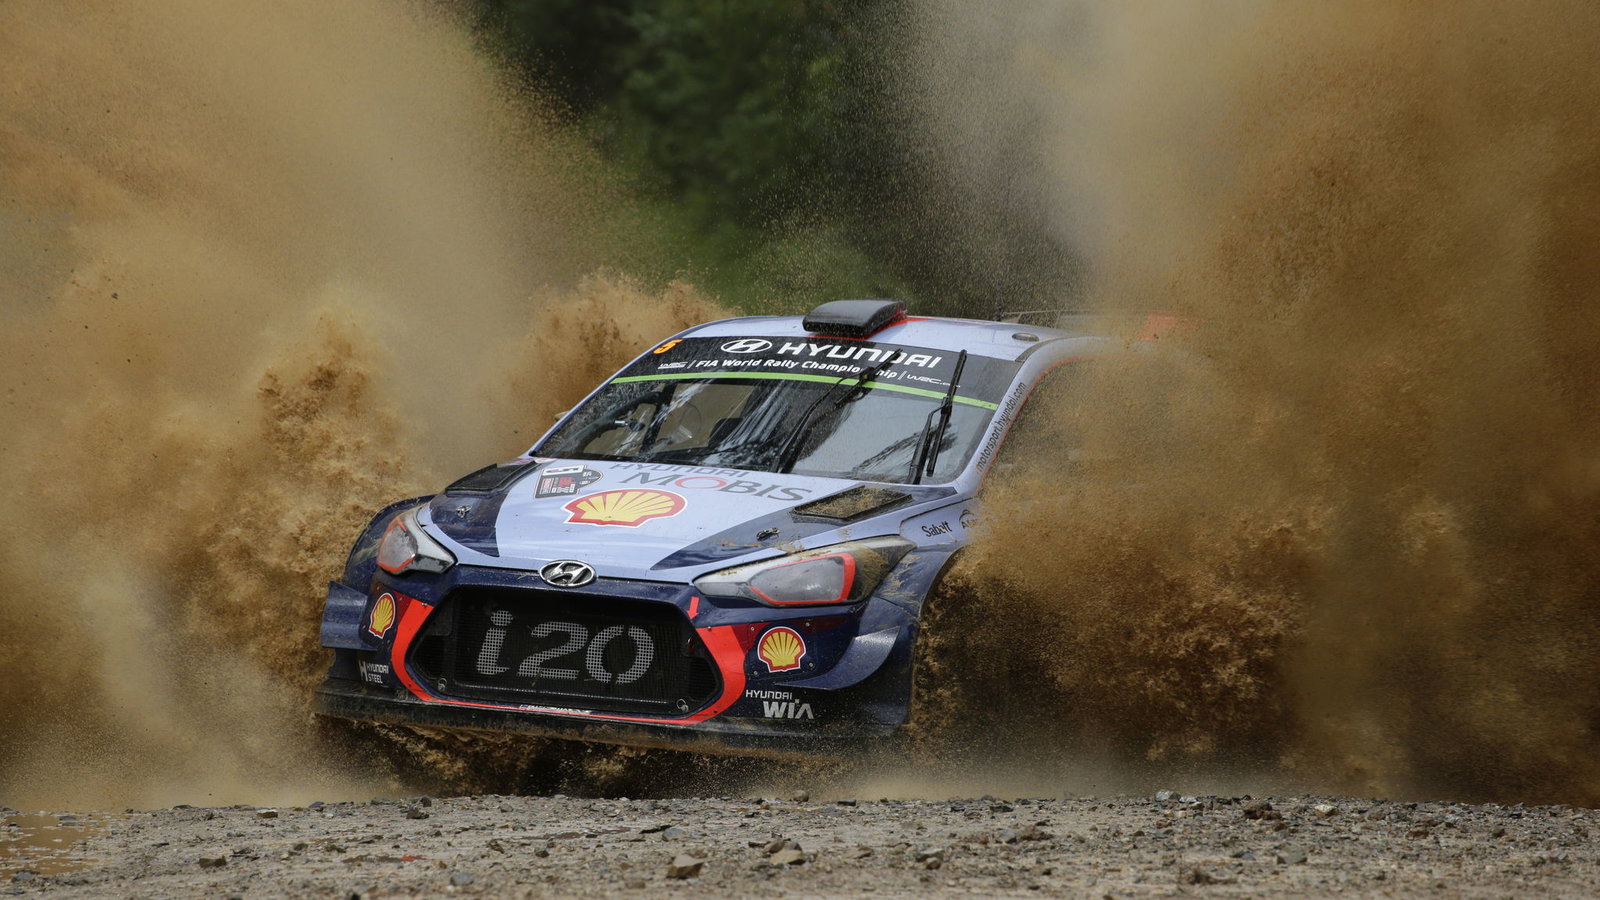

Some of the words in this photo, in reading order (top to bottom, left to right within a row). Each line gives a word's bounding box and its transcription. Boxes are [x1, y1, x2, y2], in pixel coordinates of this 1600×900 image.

[653, 339, 682, 354] 5
[777, 342, 942, 369] HYUNDAI
[695, 359, 718, 368] FIA
[720, 359, 761, 367] World
[763, 359, 800, 369] Rally
[801, 360, 898, 379] Champiohip
[975, 381, 1027, 473] motorsport.hyundai.com
[609, 463, 750, 478] HYUNDAI
[619, 472, 813, 501] MOBIS
[476, 610, 654, 684] i20
[367, 663, 389, 674] HYUNDAI
[368, 673, 384, 684] STEEL
[745, 689, 793, 700] HYUNDAI
